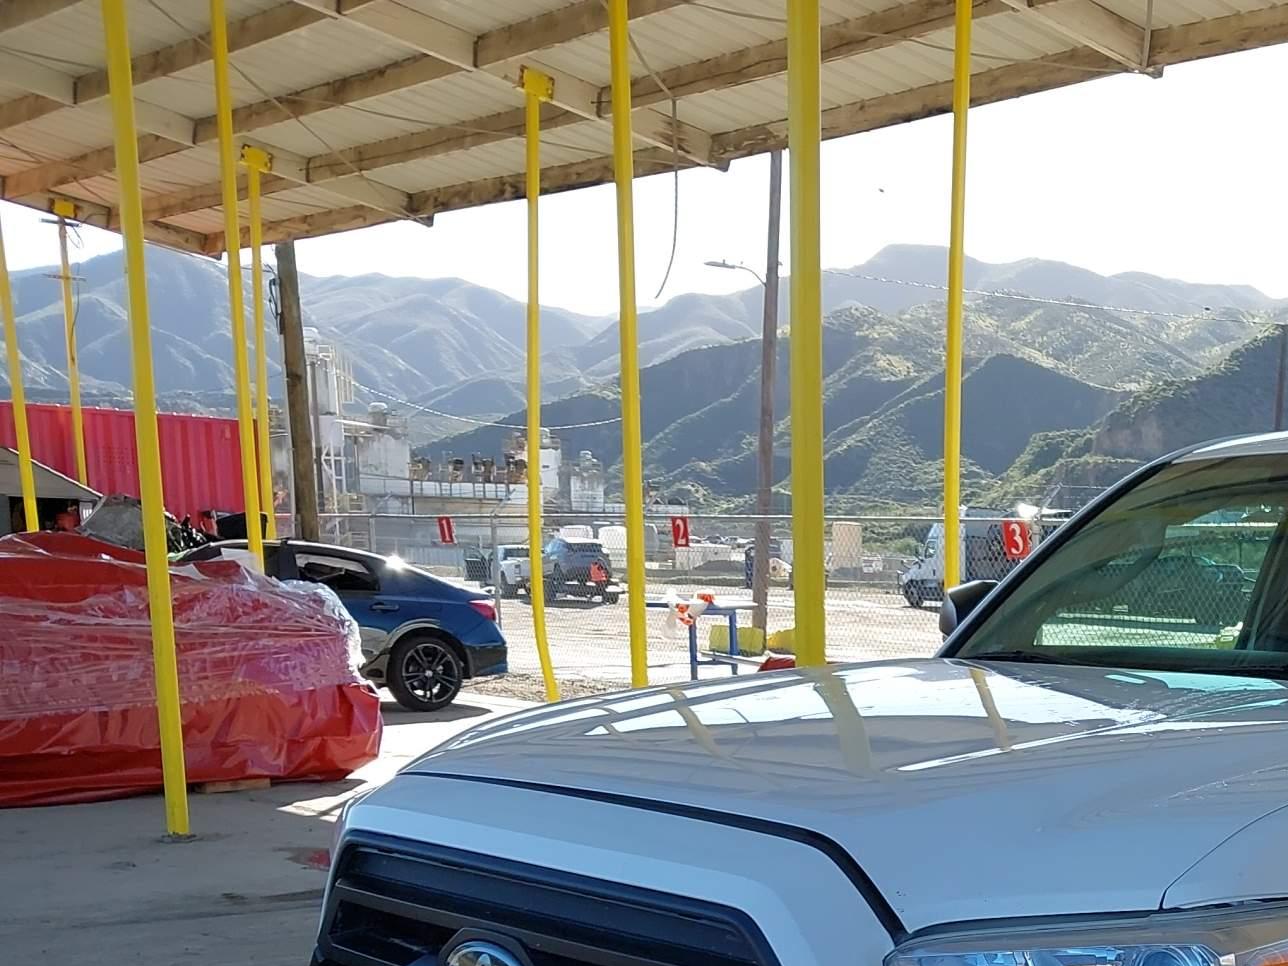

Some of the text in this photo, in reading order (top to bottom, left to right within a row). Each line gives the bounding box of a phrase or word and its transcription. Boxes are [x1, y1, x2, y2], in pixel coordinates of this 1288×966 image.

[441, 519, 451, 541] 1
[675, 518, 687, 545] 2
[1009, 523, 1024, 555] 3
